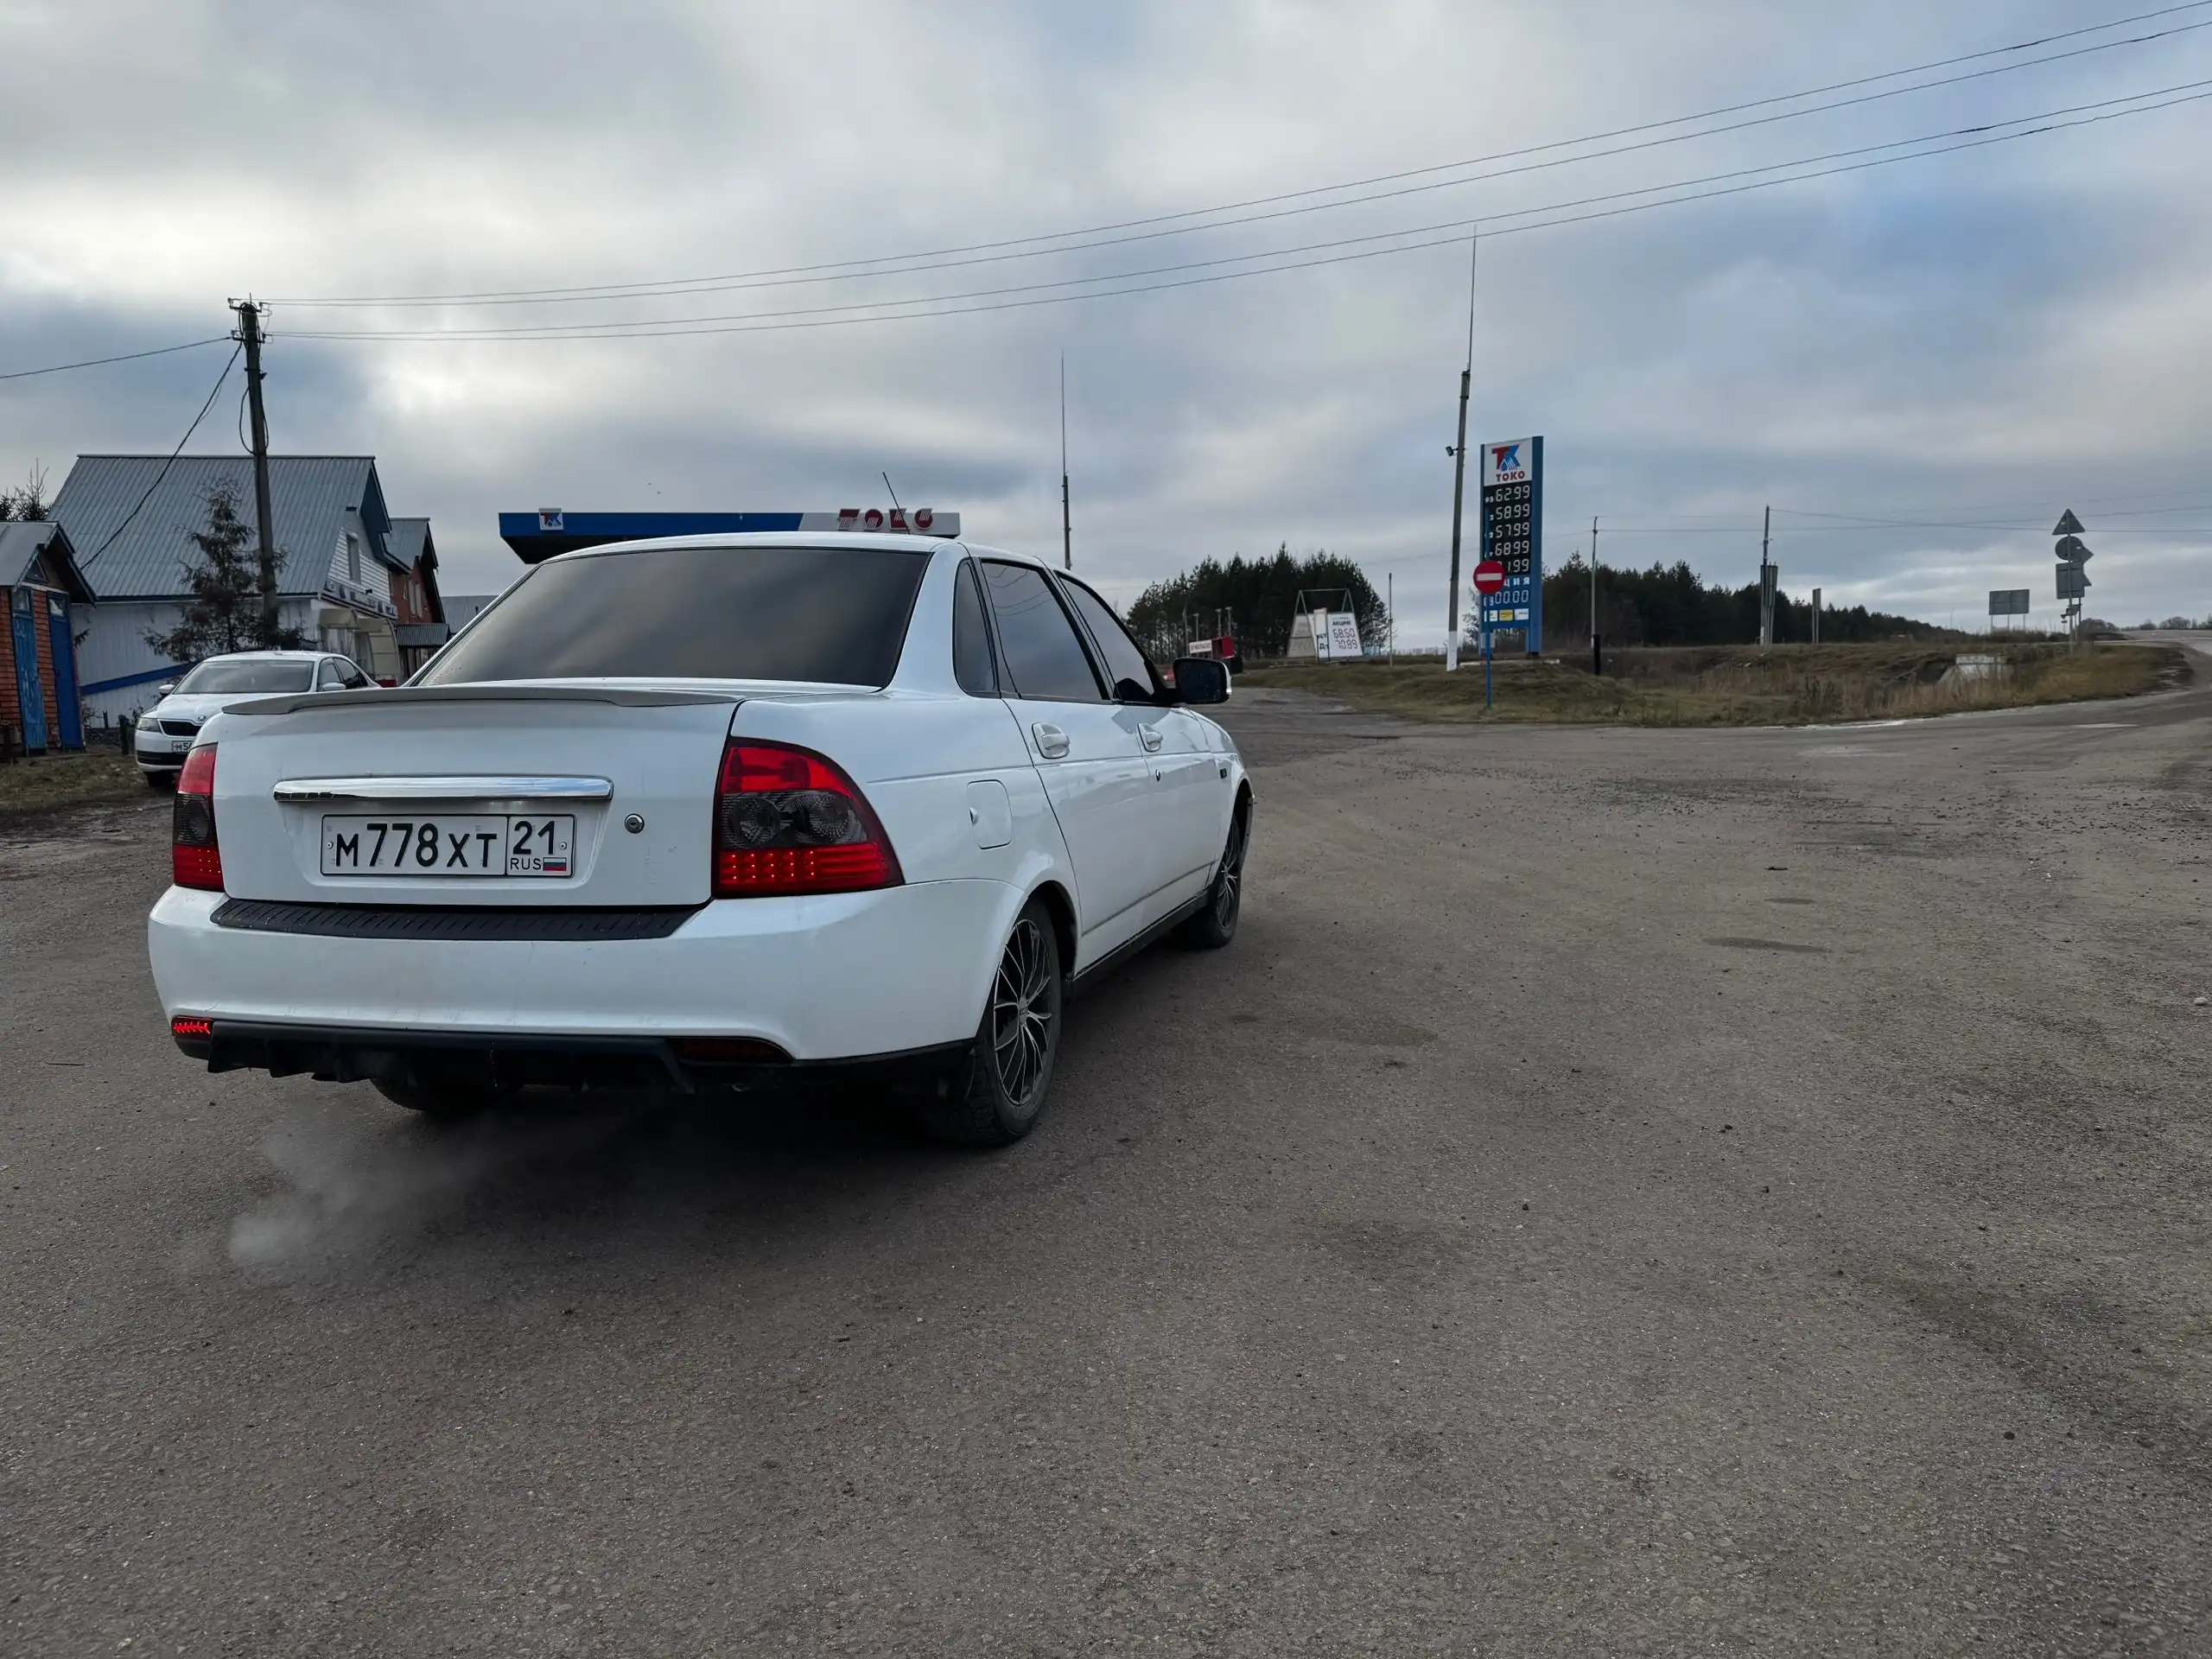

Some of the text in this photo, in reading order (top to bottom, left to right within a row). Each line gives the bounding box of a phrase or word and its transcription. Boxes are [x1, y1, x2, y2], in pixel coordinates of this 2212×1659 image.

[1496, 471, 1525, 482] ТОКО
[1496, 485, 1530, 502] 62.99
[1496, 504, 1530, 520] 58.99
[1496, 522, 1529, 538] 57.99
[1495, 540, 1529, 556] 68.99
[1503, 576, 1530, 588] ЦИЯ
[334, 820, 556, 868] М778ХТ 21
[510, 857, 542, 871] RUS
